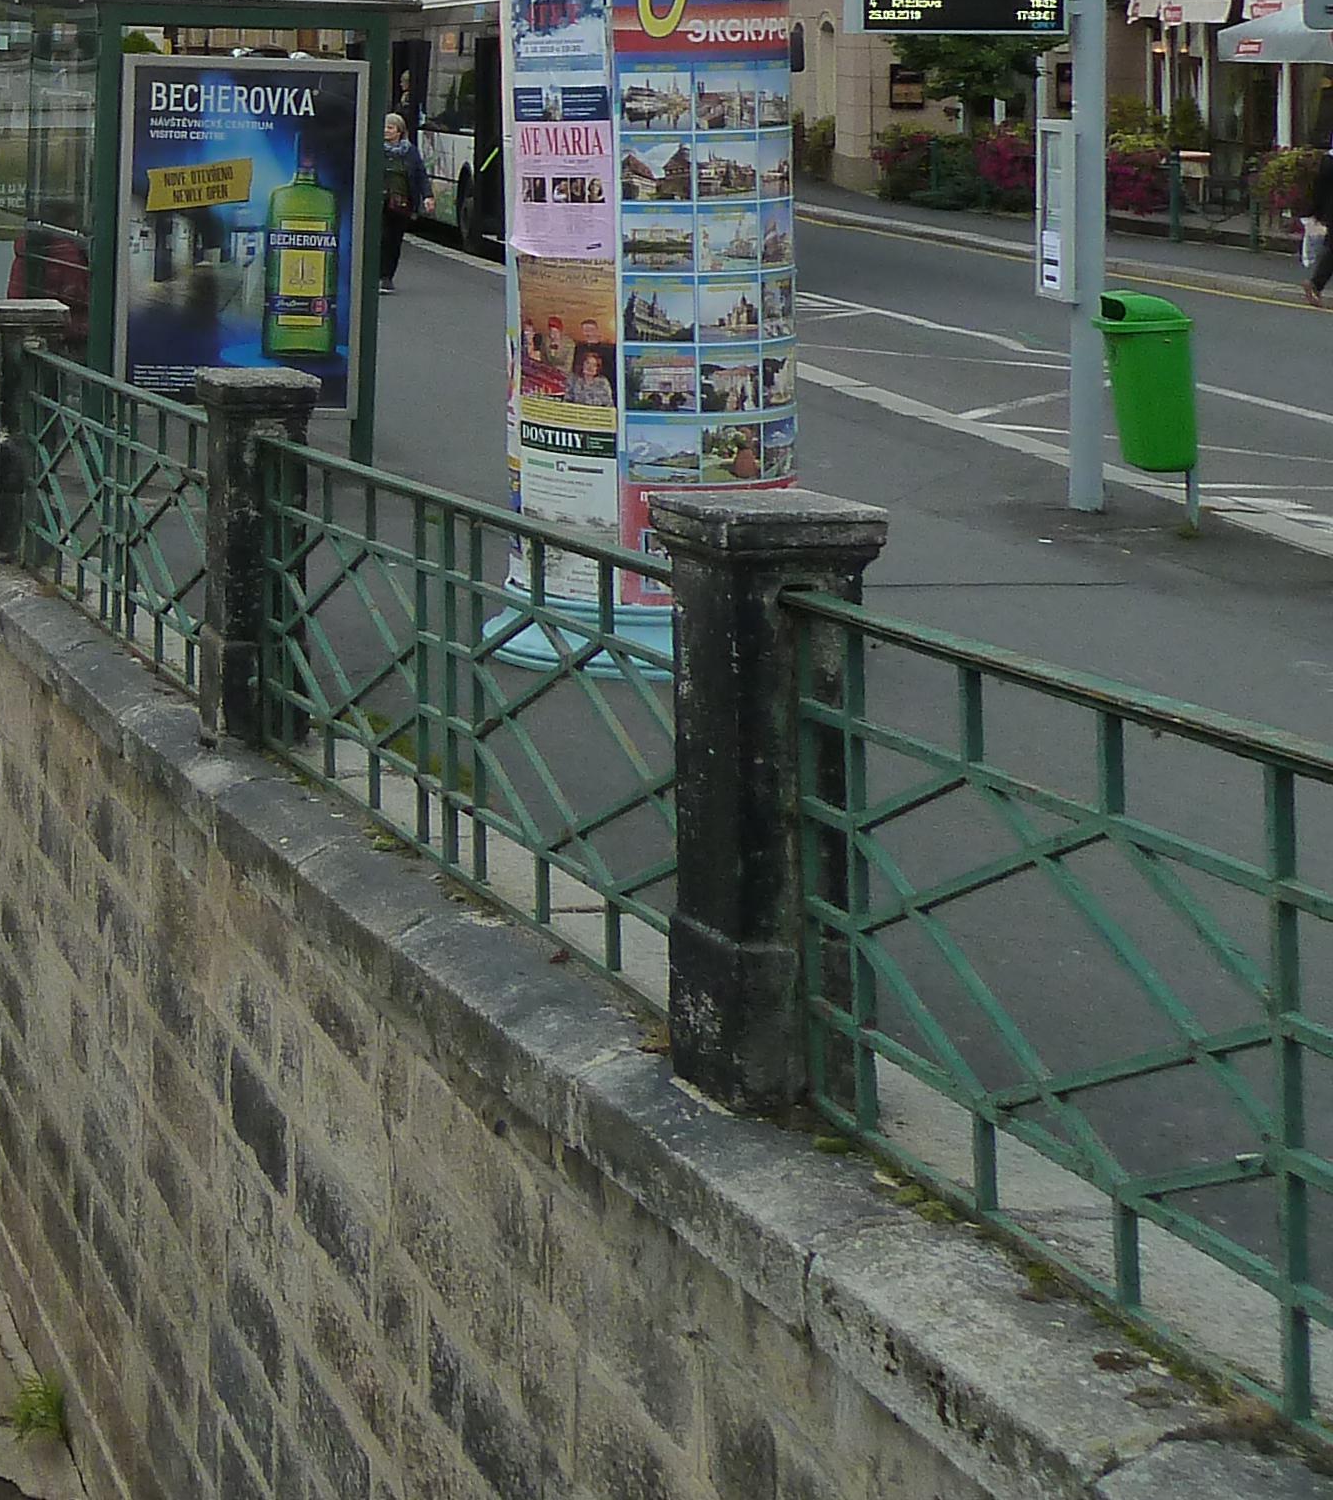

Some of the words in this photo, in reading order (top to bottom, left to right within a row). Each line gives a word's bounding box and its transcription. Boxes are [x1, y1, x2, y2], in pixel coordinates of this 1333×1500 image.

[150, 81, 317, 117] BECHEROVKA
[149, 116, 223, 130] NÁVŠTĚVNICKÉ
[225, 120, 274, 131] CENTRUM
[149, 130, 188, 140] VISITOR
[189, 131, 226, 141] CENTRE
[520, 127, 542, 156] AVE
[545, 126, 605, 156] MARIA
[173, 187, 202, 204] NEWLY
[206, 184, 229, 200] OPEN
[269, 233, 337, 248] BECHEROVKA
